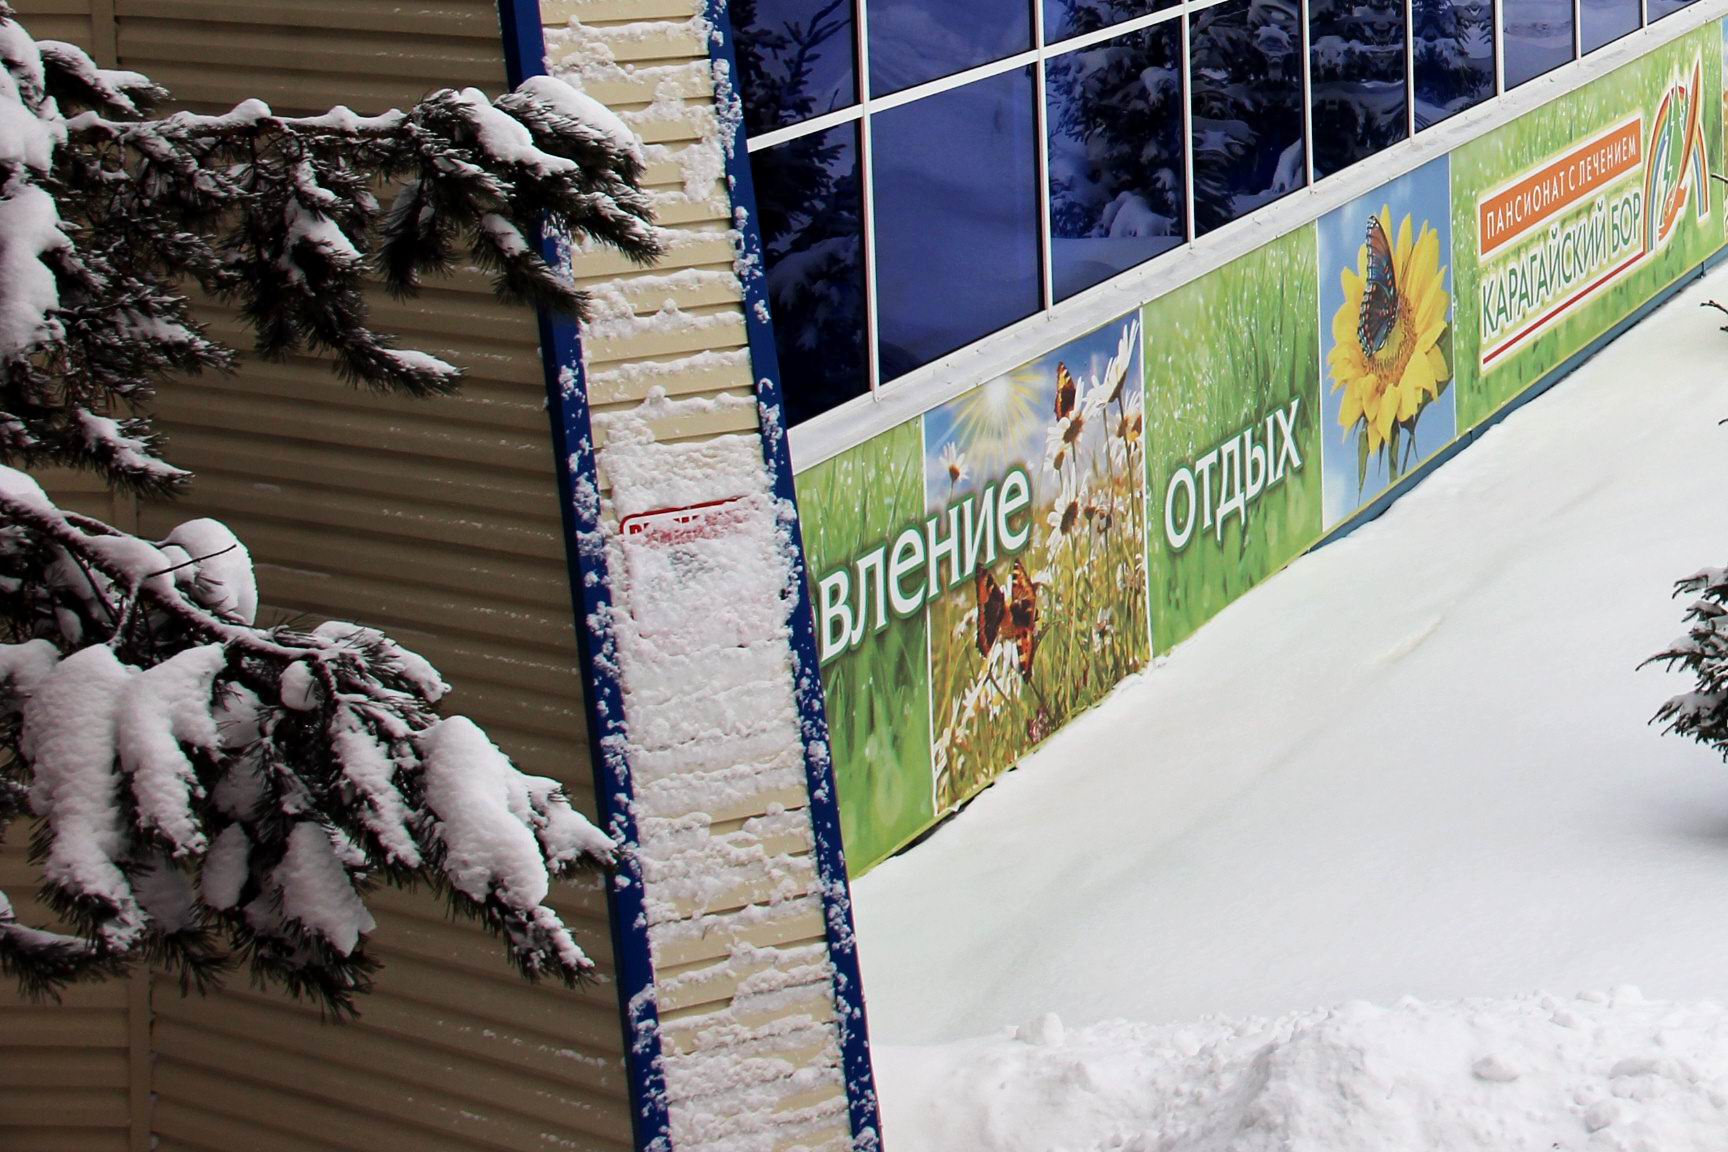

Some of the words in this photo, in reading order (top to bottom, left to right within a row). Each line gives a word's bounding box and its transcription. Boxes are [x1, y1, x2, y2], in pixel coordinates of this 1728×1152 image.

[1486, 171, 1565, 240] ПАНСИОНАТ
[1567, 172, 1576, 192] С
[1578, 134, 1636, 187] ЛЕЧЕНИЕМ
[1482, 200, 1607, 338] КАРАГАЙСКИЙ
[1611, 191, 1641, 254] БОР
[1164, 398, 1302, 550] отдых
[812, 470, 1030, 663] вление
